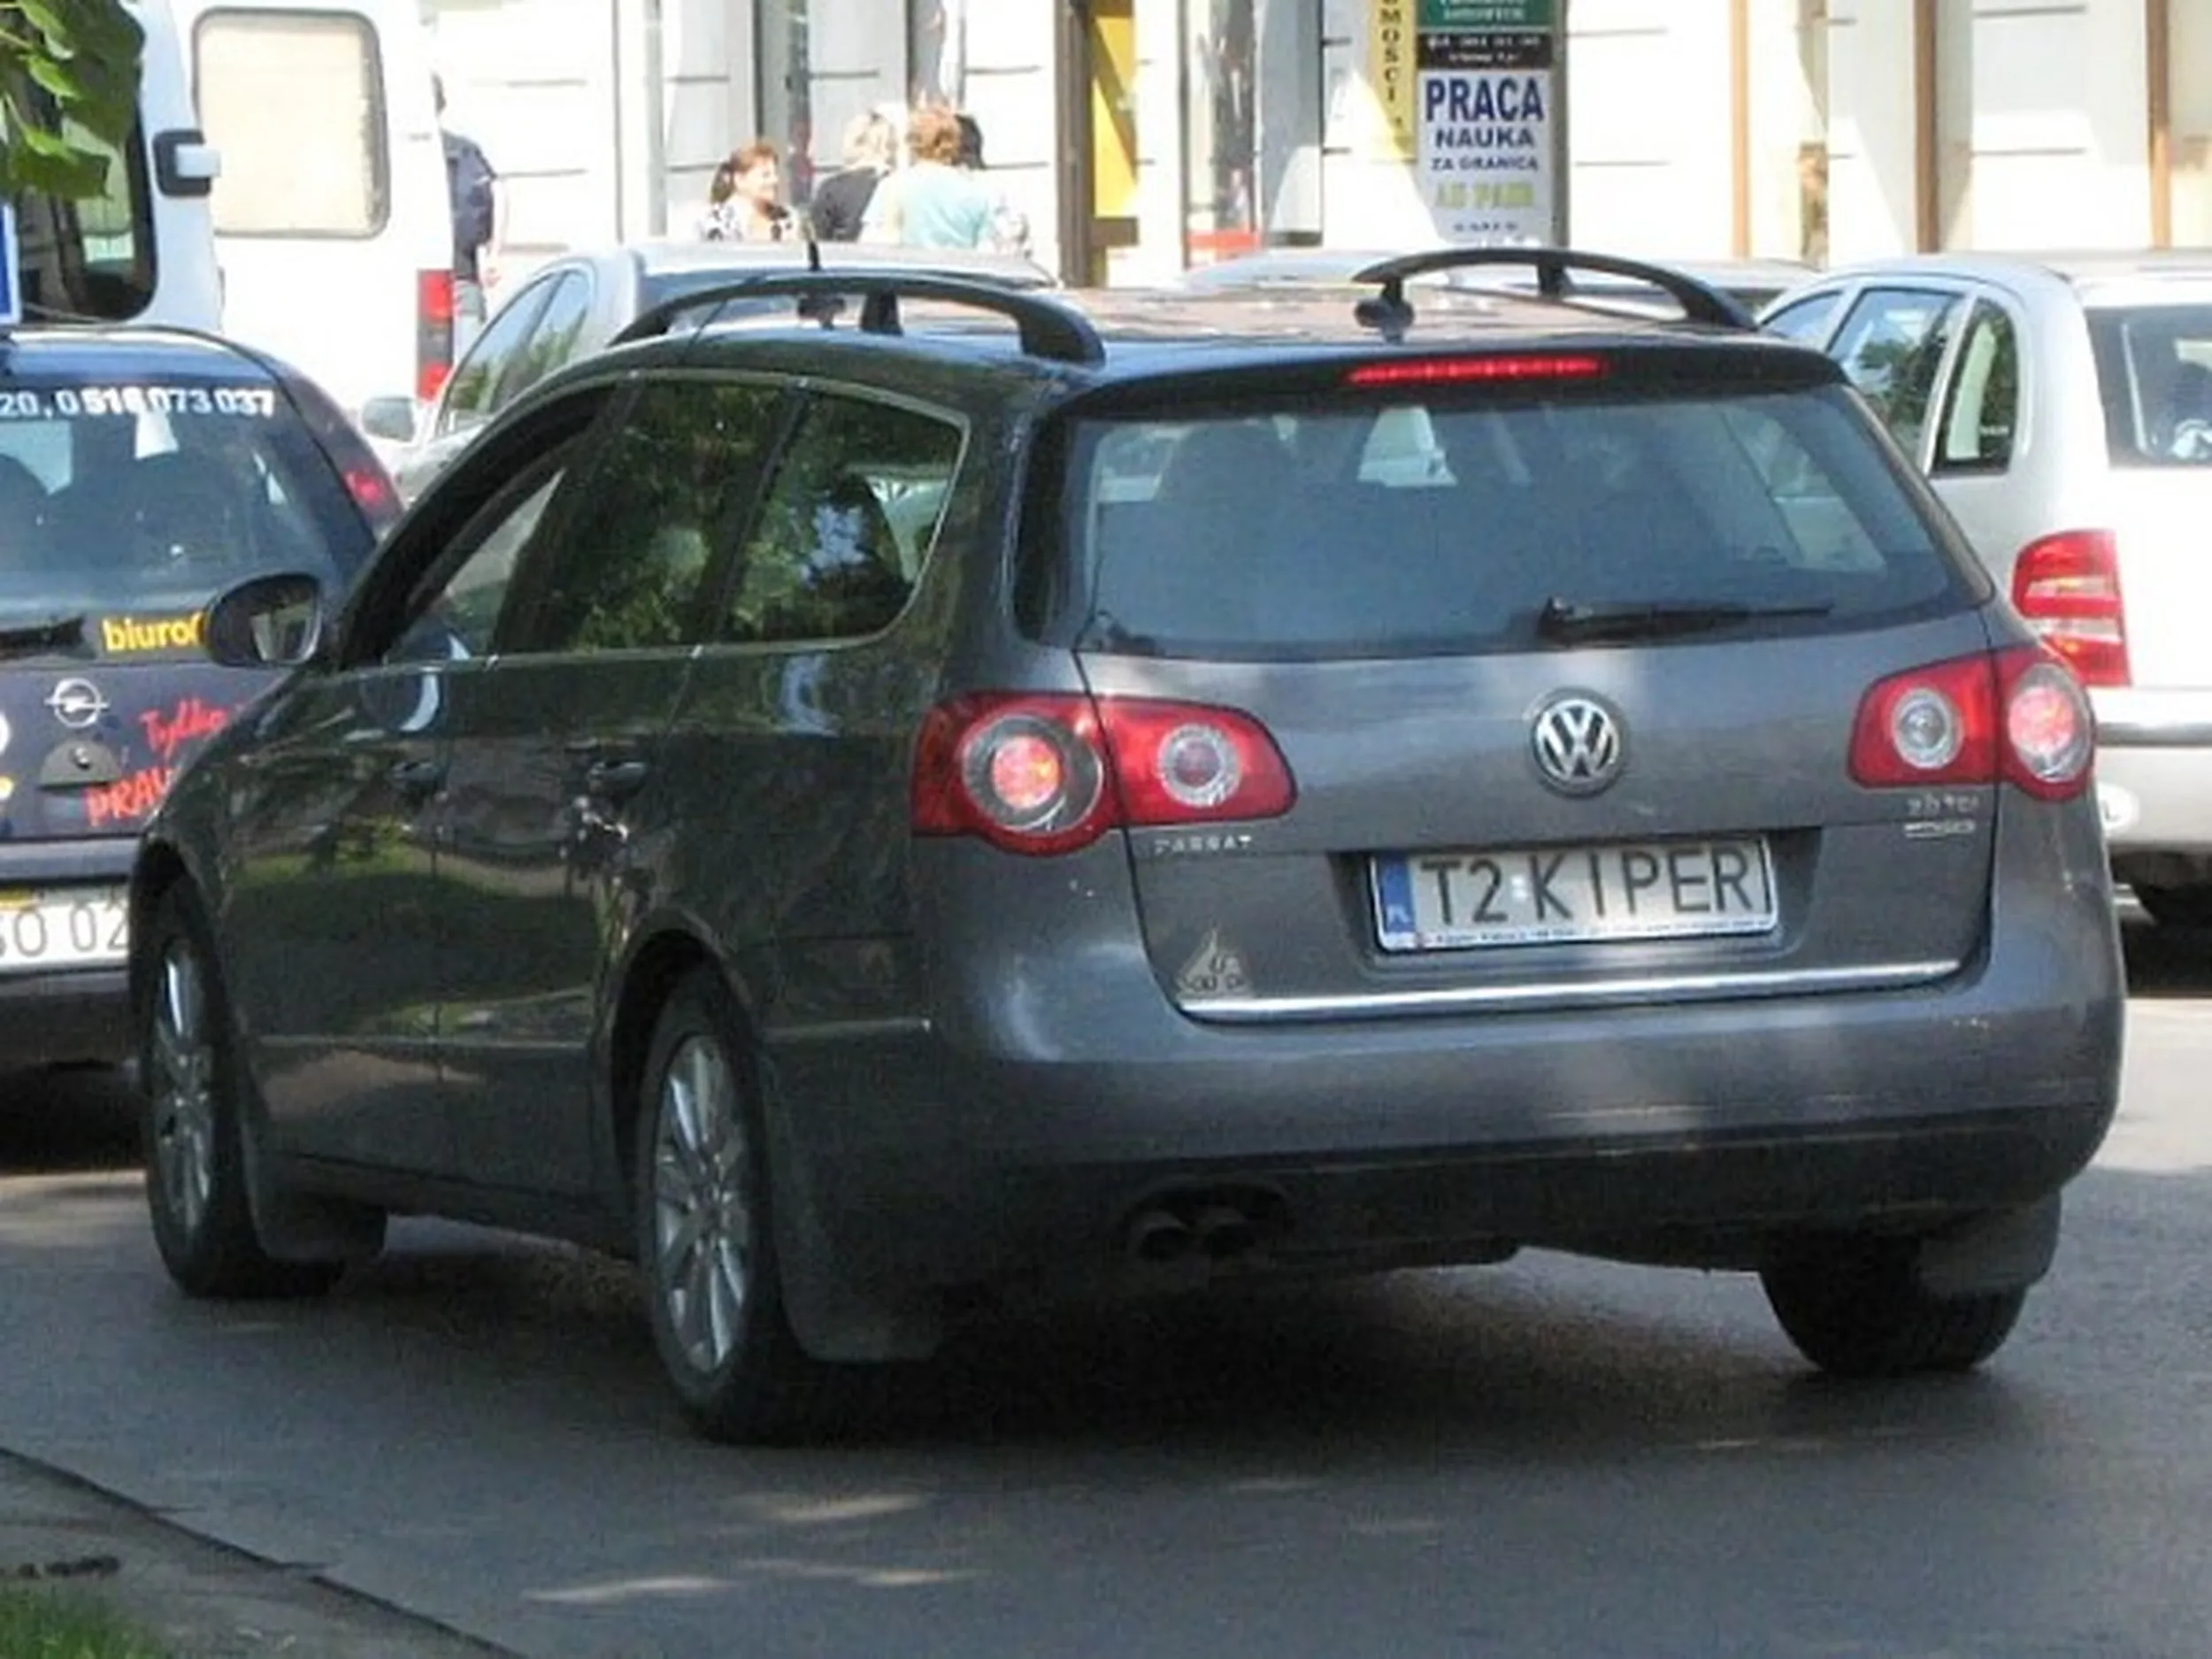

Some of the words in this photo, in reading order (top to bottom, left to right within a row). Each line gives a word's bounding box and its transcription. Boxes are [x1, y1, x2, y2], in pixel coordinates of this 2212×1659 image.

[1425, 78, 1544, 122] PRACA
[1436, 128, 1535, 149] NAUKA
[1431, 157, 1454, 171] ZA
[1529, 846, 1752, 920] KIPER
